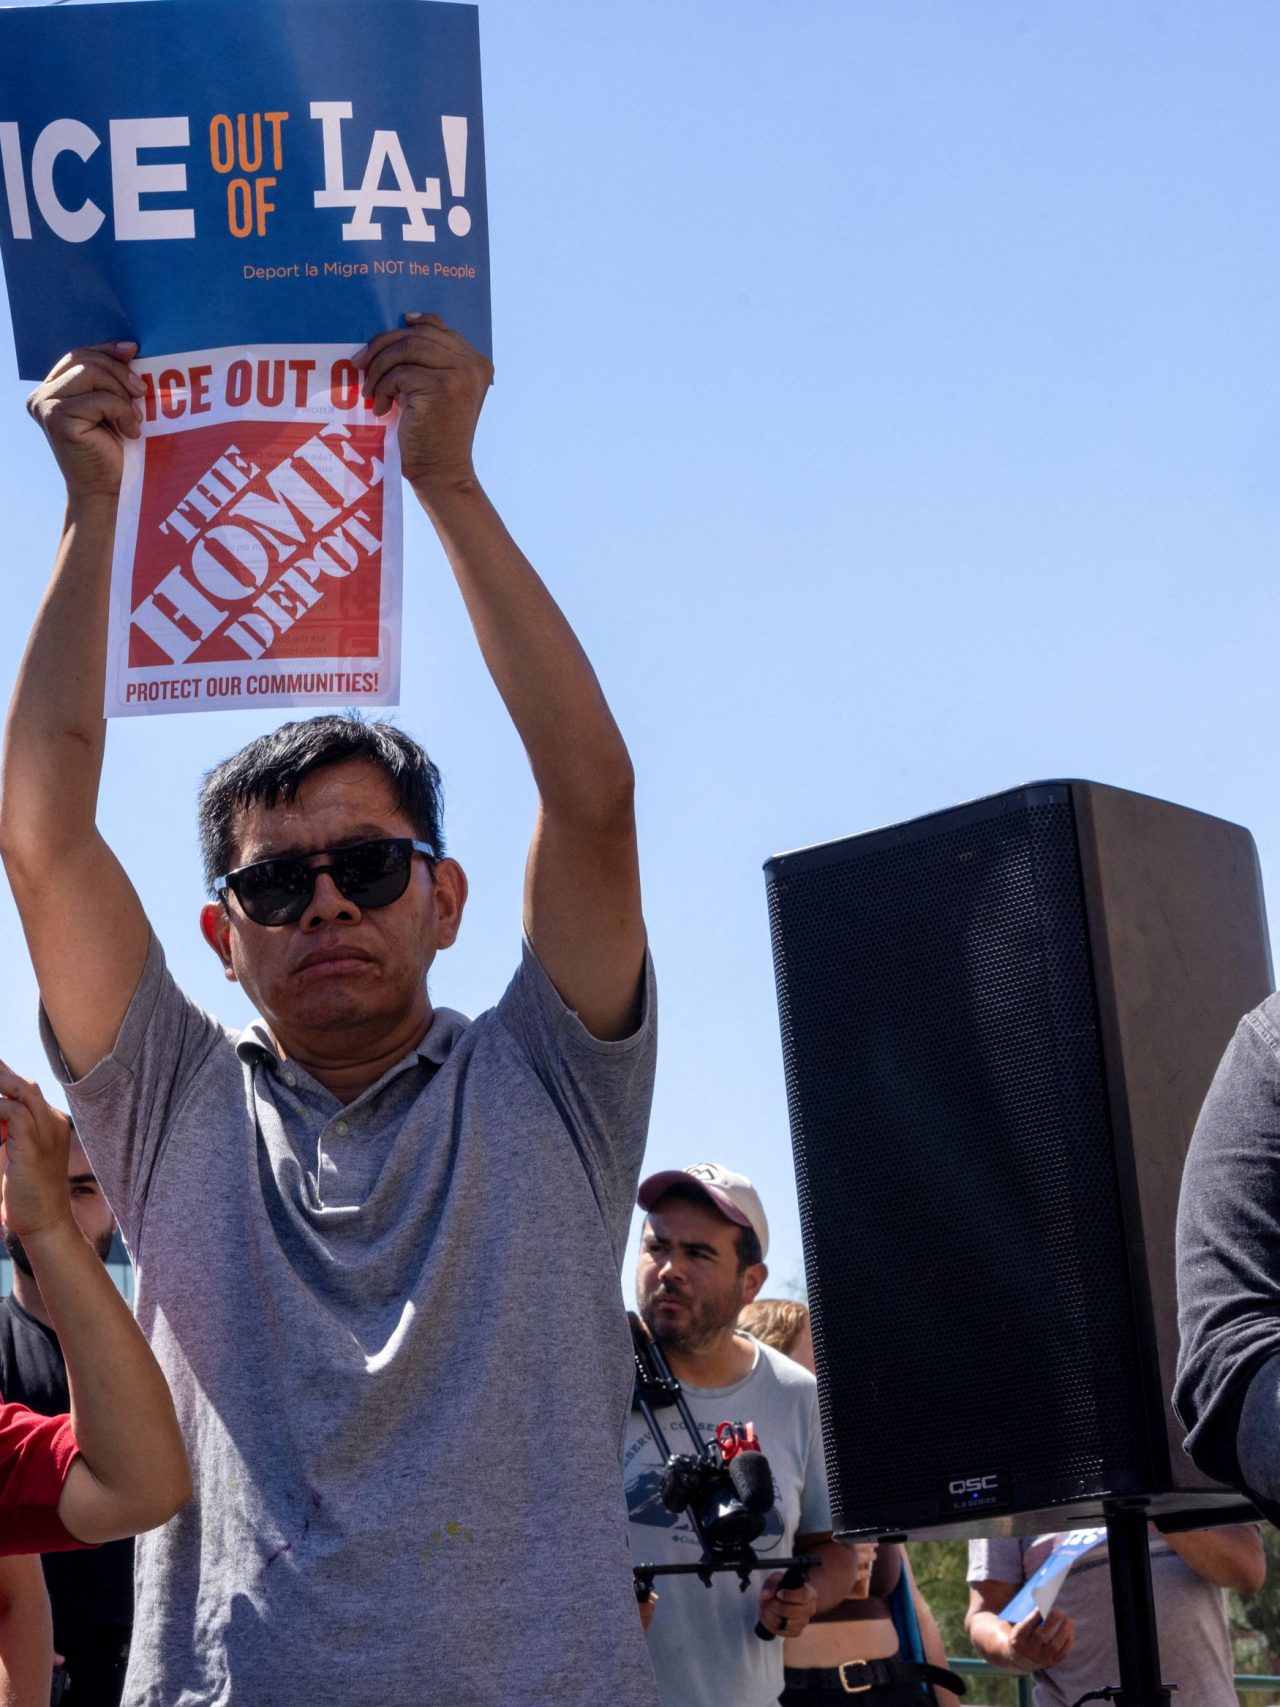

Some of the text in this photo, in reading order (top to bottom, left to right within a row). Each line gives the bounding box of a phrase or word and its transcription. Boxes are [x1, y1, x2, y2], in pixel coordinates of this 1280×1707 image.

[209, 111, 289, 174] OUT
[309, 101, 472, 243] LA!
[227, 177, 277, 239] OF
[242, 260, 476, 280] Deport la Migra NOT the People
[141, 358, 375, 422] ICE OUT O
[158, 444, 262, 545] THE
[129, 423, 386, 665] HOME
[223, 509, 384, 661] DEPOT
[126, 673, 379, 702] PROTECT OUR COMMUNITIES!
[949, 1474, 998, 1494] QSC
